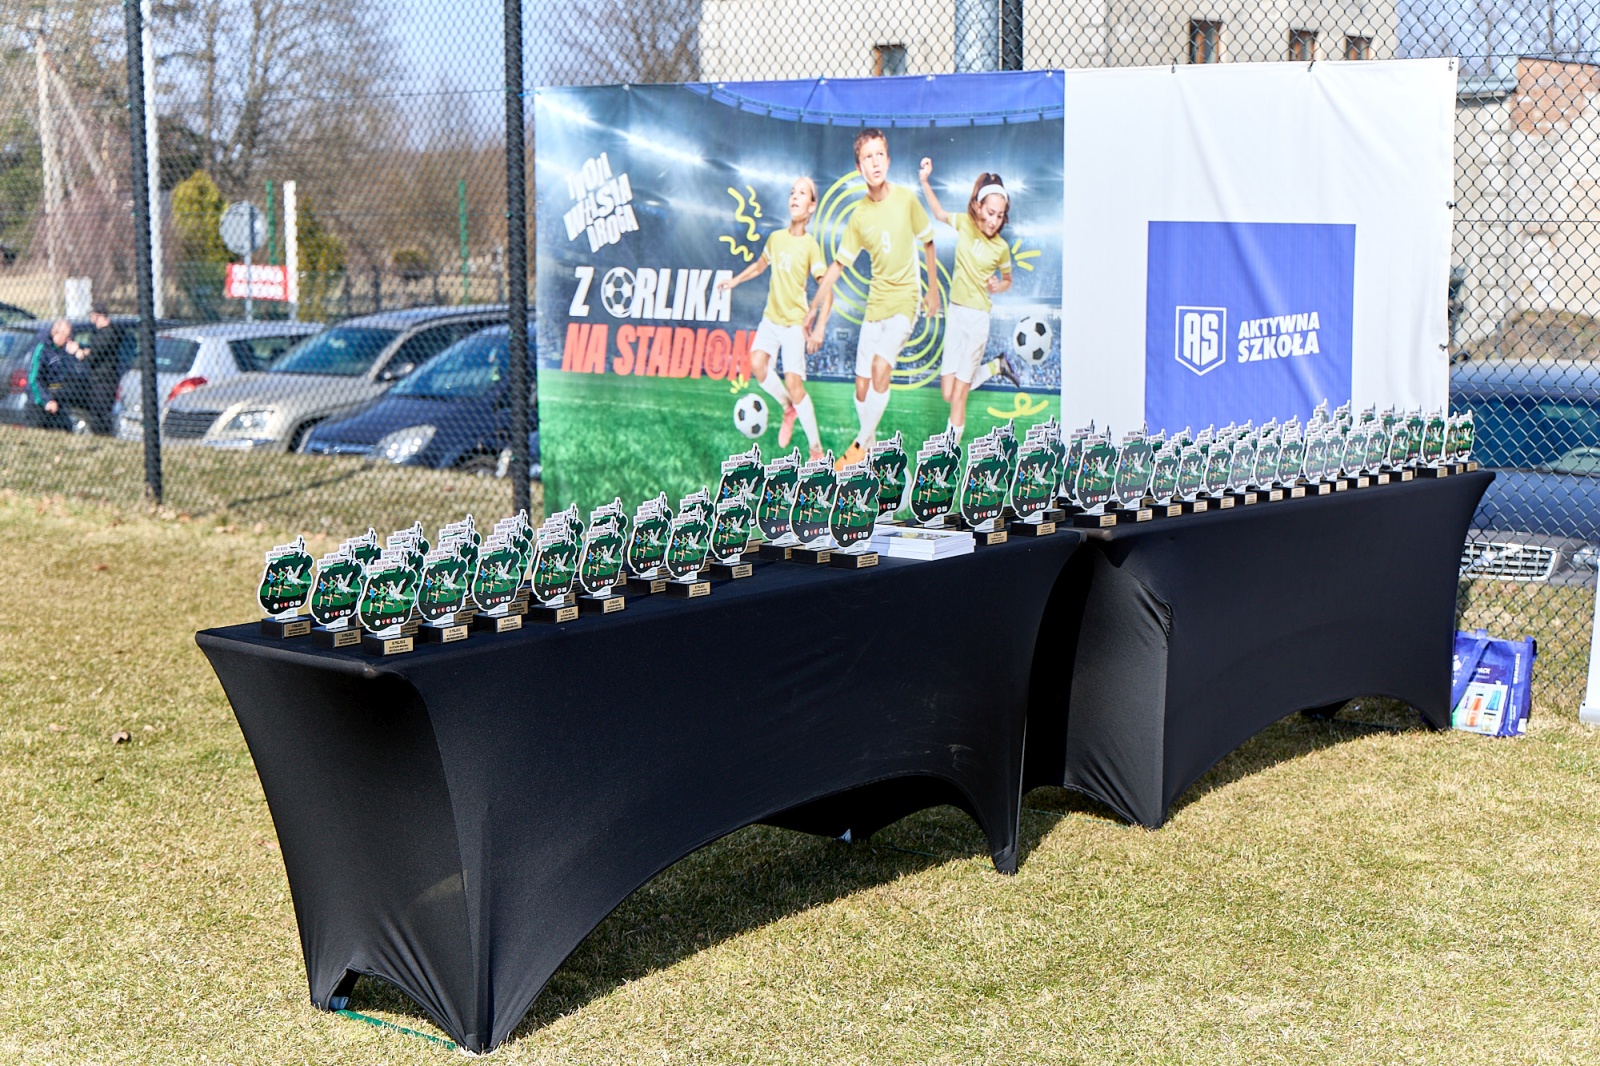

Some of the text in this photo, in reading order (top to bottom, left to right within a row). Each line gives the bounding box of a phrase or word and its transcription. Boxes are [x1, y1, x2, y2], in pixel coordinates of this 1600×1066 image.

[881, 231, 891, 254] 9
[569, 266, 594, 317] Z
[1183, 312, 1219, 366] AS
[1238, 311, 1320, 340] AKTYWNA
[561, 323, 757, 381] NA STADION
[1238, 331, 1320, 364] SZKOŁA
